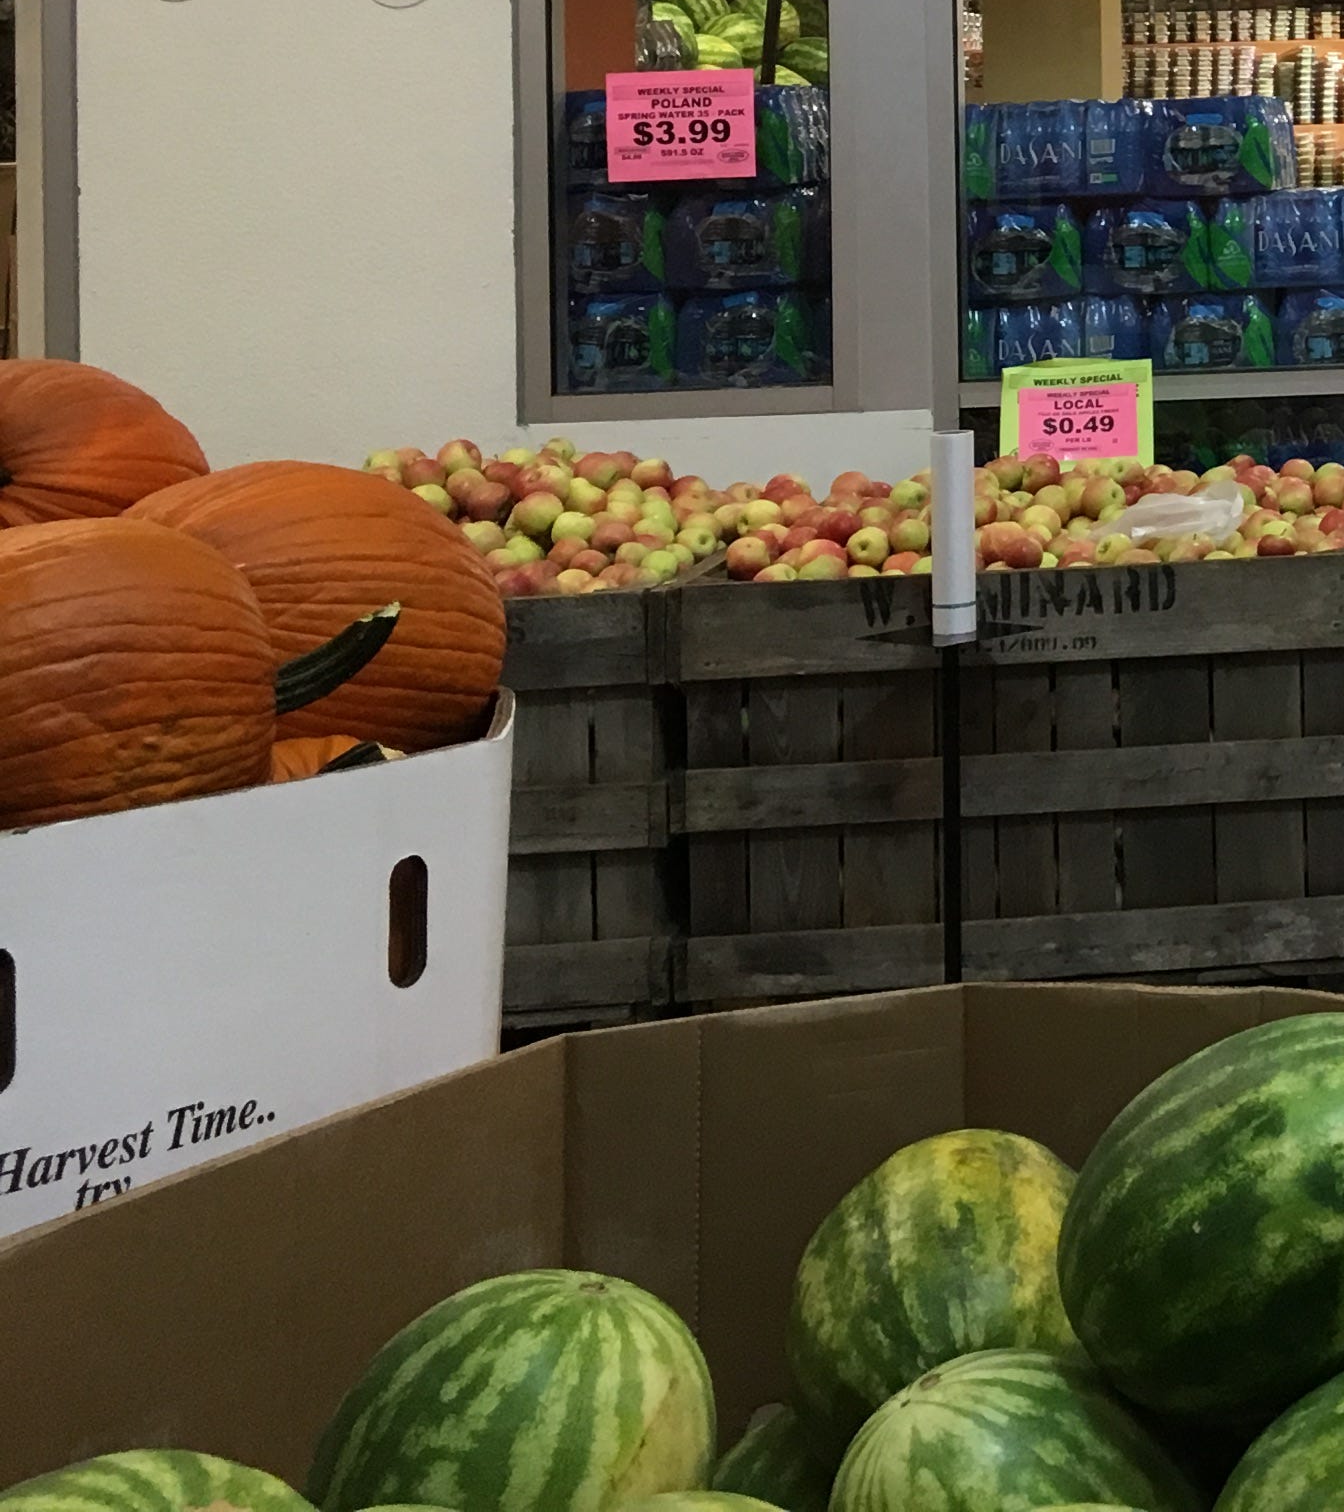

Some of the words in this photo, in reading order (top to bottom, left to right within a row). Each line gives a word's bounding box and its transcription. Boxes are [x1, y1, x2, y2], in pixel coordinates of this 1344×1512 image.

[637, 88, 679, 96] WEEKLY
[682, 86, 724, 94] SPECIAL
[651, 97, 712, 110] POLAND
[618, 112, 656, 120] SPRING
[659, 110, 694, 119] WATER
[633, 119, 731, 146] $3.99
[1000, 141, 1082, 168] DASANI
[1258, 229, 1340, 257] DASANI
[1033, 377, 1077, 386] WEEKLY
[1080, 374, 1123, 384] SPECIAL
[1054, 399, 1104, 410] LOCAL
[1042, 415, 1114, 436] $0.49
[0, 1121, 154, 1196] Harvest
